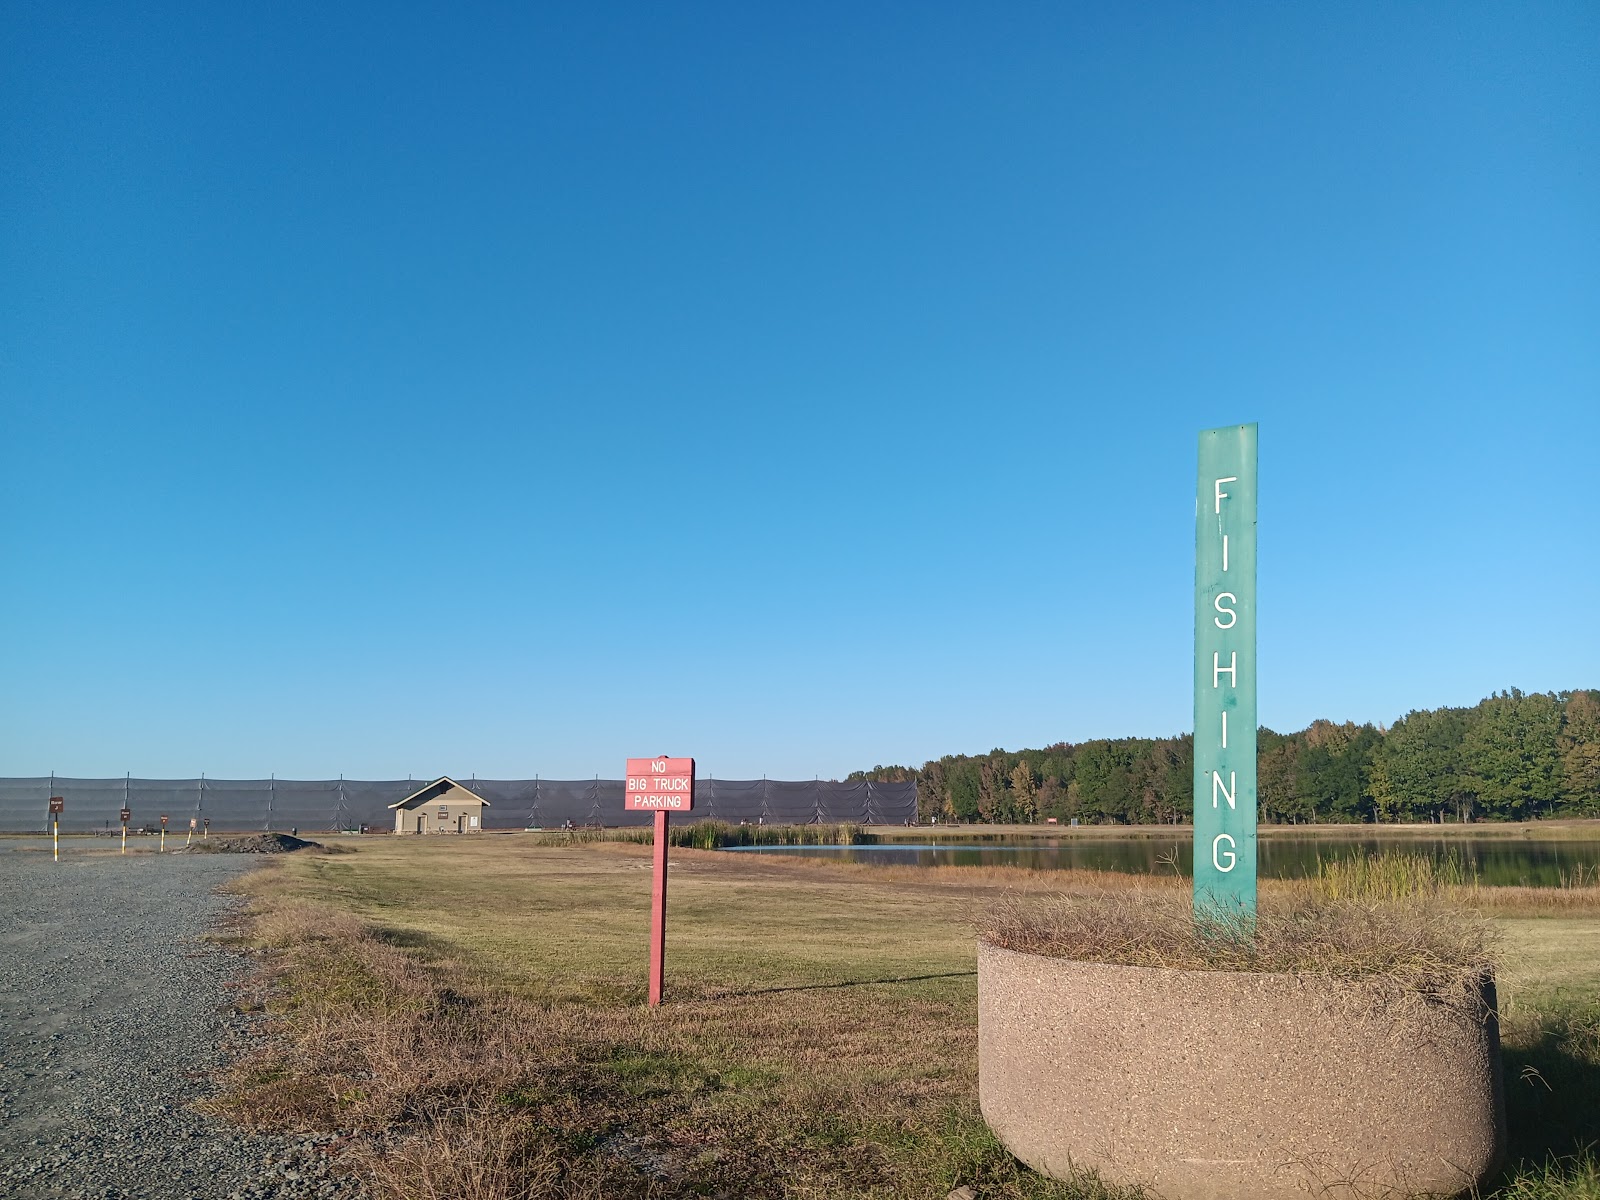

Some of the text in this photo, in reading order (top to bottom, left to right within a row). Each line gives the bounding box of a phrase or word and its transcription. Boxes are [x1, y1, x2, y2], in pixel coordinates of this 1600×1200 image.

[1212, 476, 1238, 873] FISHING
[651, 761, 666, 773] NO
[628, 778, 688, 790] BIG TRUCK
[634, 795, 681, 808] PARKING
